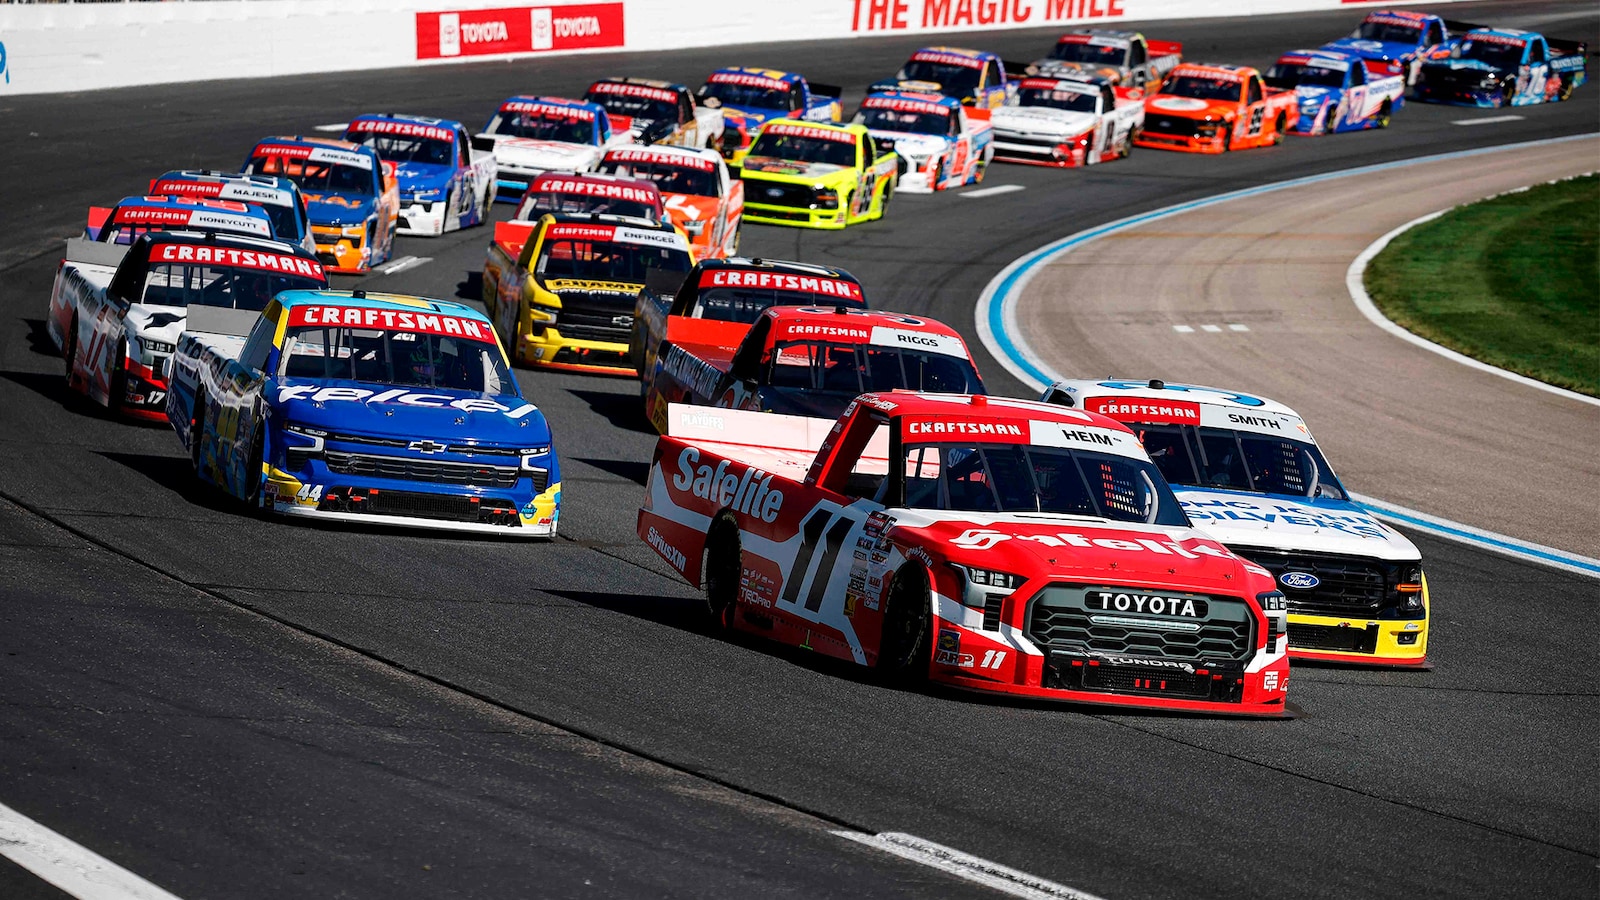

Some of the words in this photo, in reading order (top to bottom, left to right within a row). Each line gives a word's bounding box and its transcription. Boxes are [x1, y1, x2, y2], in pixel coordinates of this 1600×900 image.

[851, 0, 907, 31] THE
[922, 0, 1032, 27] MAGIC
[1045, 0, 1125, 20] MILE
[461, 21, 508, 44] TOYOTA
[553, 16, 600, 37] TOYOTA
[712, 74, 782, 89] CRAFTSMAN
[596, 84, 671, 101] CRAFTSMAN
[505, 103, 590, 119] CRAFTSMAN
[866, 97, 950, 116] CRAFTSMAN
[356, 121, 447, 140] CRAFTSMAN
[769, 125, 852, 143] CRAFTSMAN
[260, 146, 309, 156] CRAFTSMAN
[612, 150, 708, 170] CRAFTSMAN
[163, 183, 219, 193] CRAFTSMAN
[233, 188, 279, 200] MAJESKI
[541, 180, 648, 200] CRAFTSMAN
[124, 210, 188, 221] CRAFTSMAN
[199, 215, 258, 229] HONEYCUTT
[552, 227, 613, 237] CRAFTSMAN
[623, 231, 676, 245] ENFINGER
[162, 245, 313, 275] CRAFTSMAN
[712, 271, 851, 296] CRAFTSMAN
[304, 307, 482, 338] CRAFTSMAN
[787, 325, 867, 338] CRAFTSMAN
[897, 333, 939, 347] RIGGS
[148, 391, 165, 404] 17
[1098, 403, 1196, 418] CRAFTSMAN
[680, 412, 724, 430] PLAYOFFS
[909, 421, 1021, 436] CRAFTSMAN
[1228, 413, 1281, 429] SMITH
[1061, 428, 1114, 446] HEIM
[296, 483, 324, 502] 44
[673, 446, 784, 523] Safelite
[647, 526, 687, 572] SiriusXM
[906, 545, 933, 568] GOODYEAR
[782, 508, 857, 614] 11
[1286, 573, 1315, 586] Ford
[1098, 592, 1197, 617] TOYOTA
[980, 650, 1008, 669] 11
[1106, 655, 1197, 675] TUNDRA
